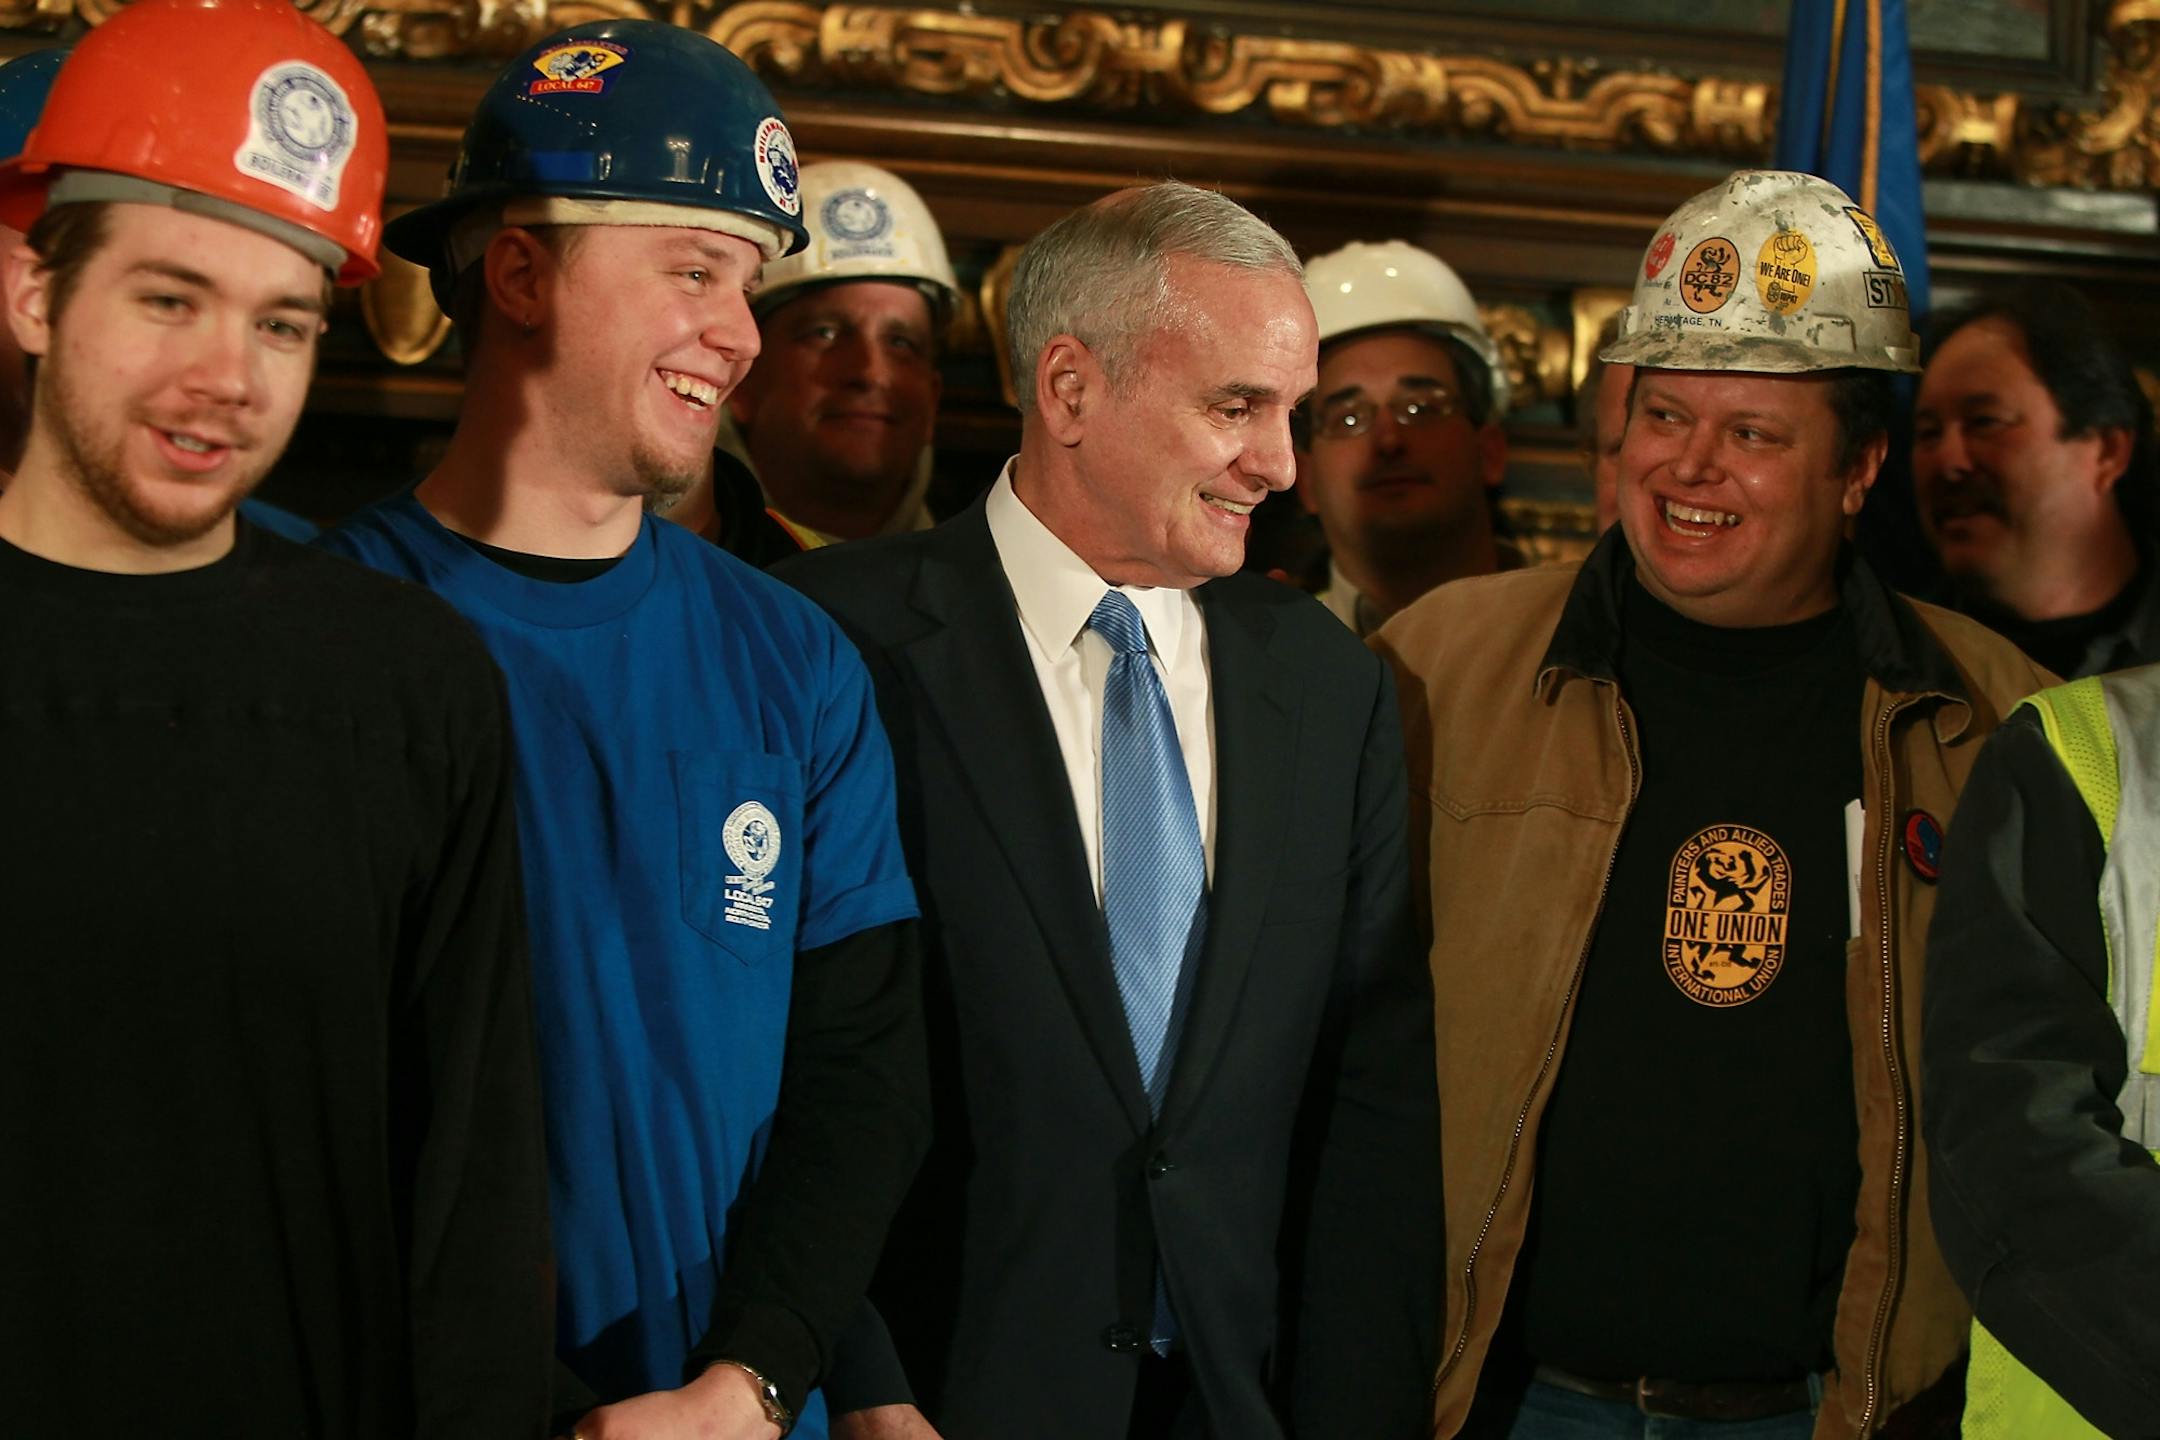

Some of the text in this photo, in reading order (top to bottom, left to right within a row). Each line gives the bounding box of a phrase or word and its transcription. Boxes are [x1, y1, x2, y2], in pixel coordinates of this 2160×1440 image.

[537, 81, 594, 91] LOCAL 647
[1760, 261, 1774, 277] WE
[1774, 265, 1791, 281] ARE
[1709, 318, 1722, 327] TN
[1672, 828, 1787, 909] PAINTERS AND ALLIED TRADES
[1670, 909, 1783, 943] ONE UNION
[1667, 943, 1780, 1003] INTERNATIONAL UNION
